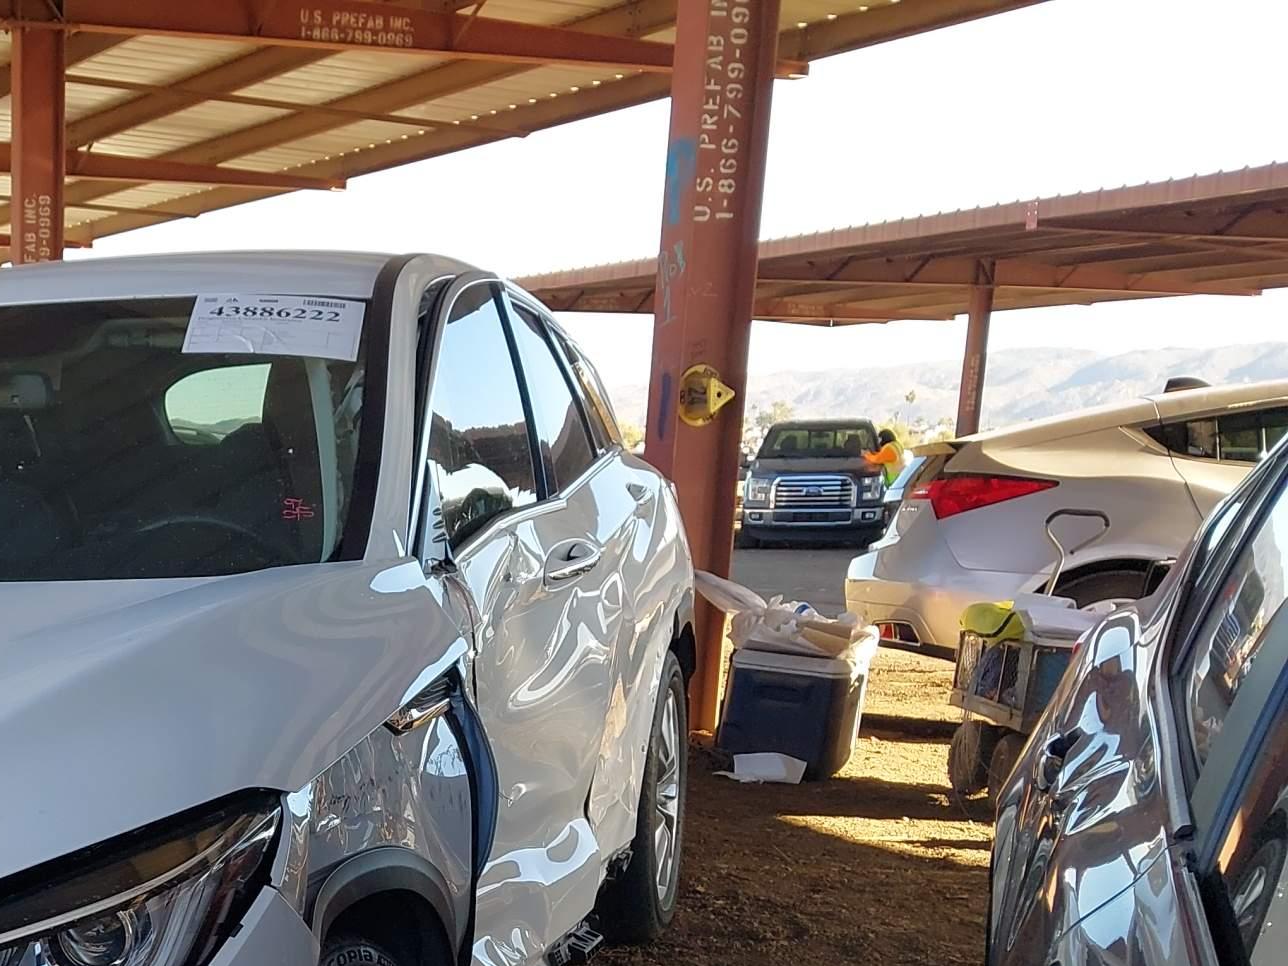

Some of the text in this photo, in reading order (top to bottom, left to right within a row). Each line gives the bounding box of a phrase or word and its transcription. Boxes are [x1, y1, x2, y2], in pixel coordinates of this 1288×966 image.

[332, 11, 384, 29] PREFAB
[699, 35, 725, 149] PREFAB
[715, 0, 750, 219] 1-866-799-09
[693, 168, 715, 222] U.S.
[38, 195, 51, 259] 9-0969
[208, 306, 341, 323] 43886222
